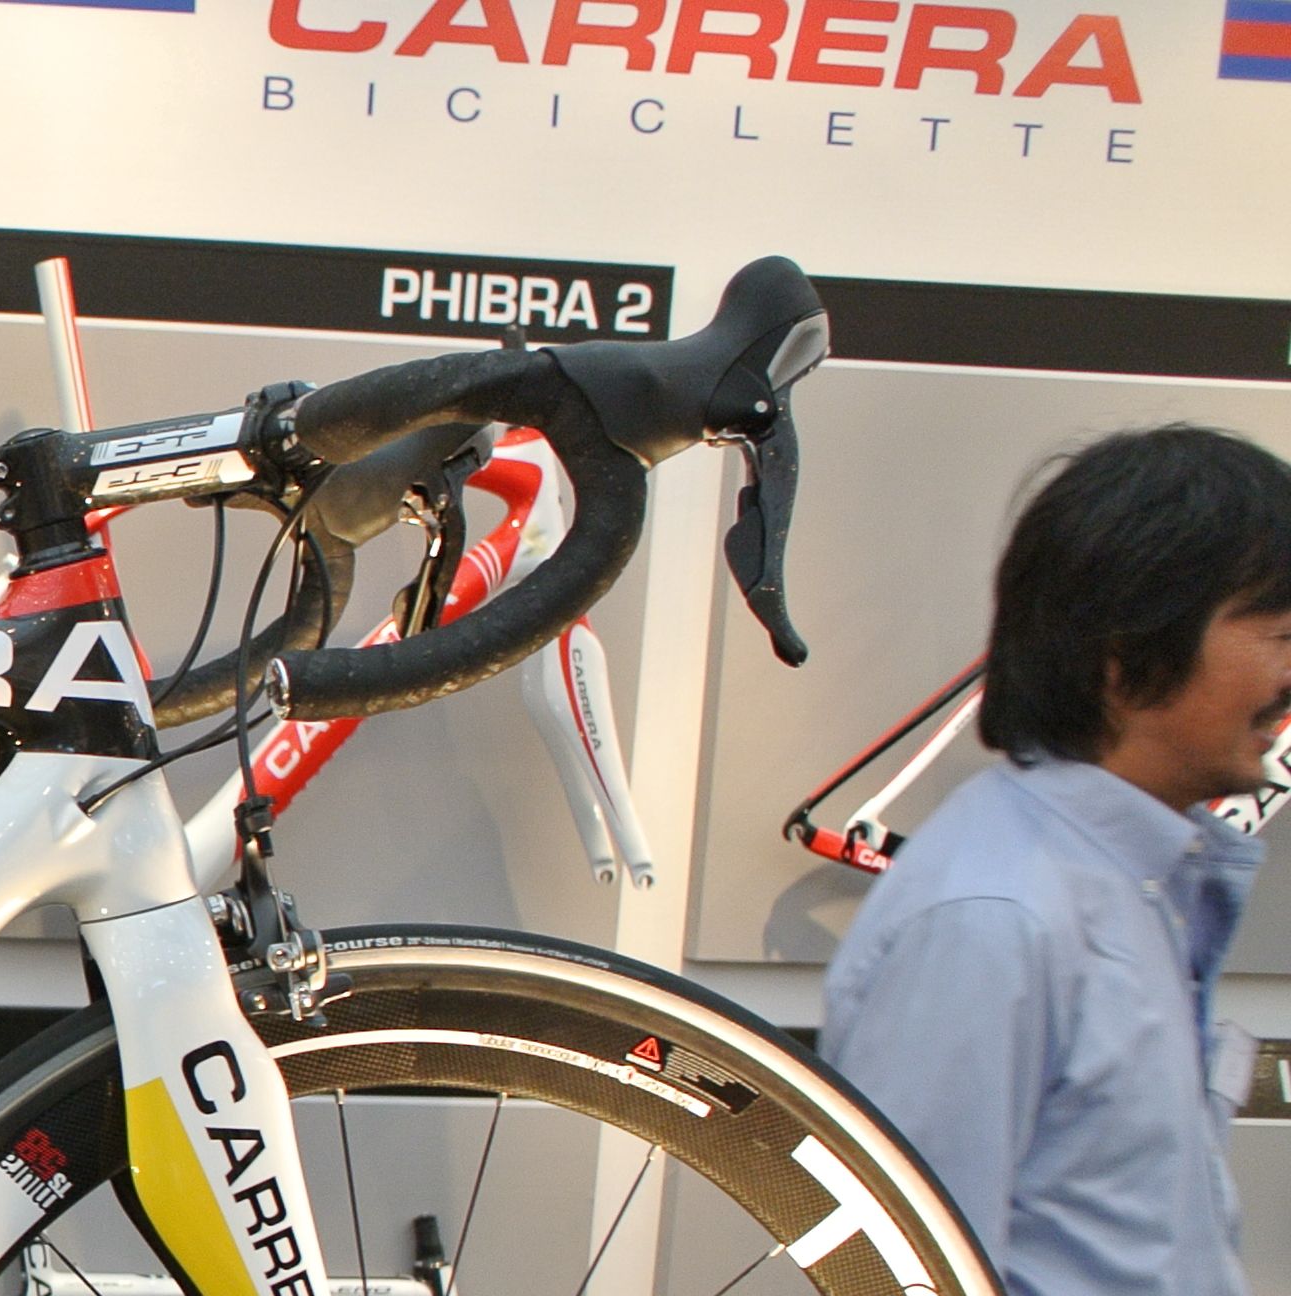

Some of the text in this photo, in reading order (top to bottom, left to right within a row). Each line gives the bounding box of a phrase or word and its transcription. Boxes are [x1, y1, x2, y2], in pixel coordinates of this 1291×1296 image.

[267, 0, 1144, 105] CARRERA
[263, 74, 1137, 165] BICICLETTE
[380, 267, 652, 334] PHIBRA 2
[323, 935, 403, 953] course
